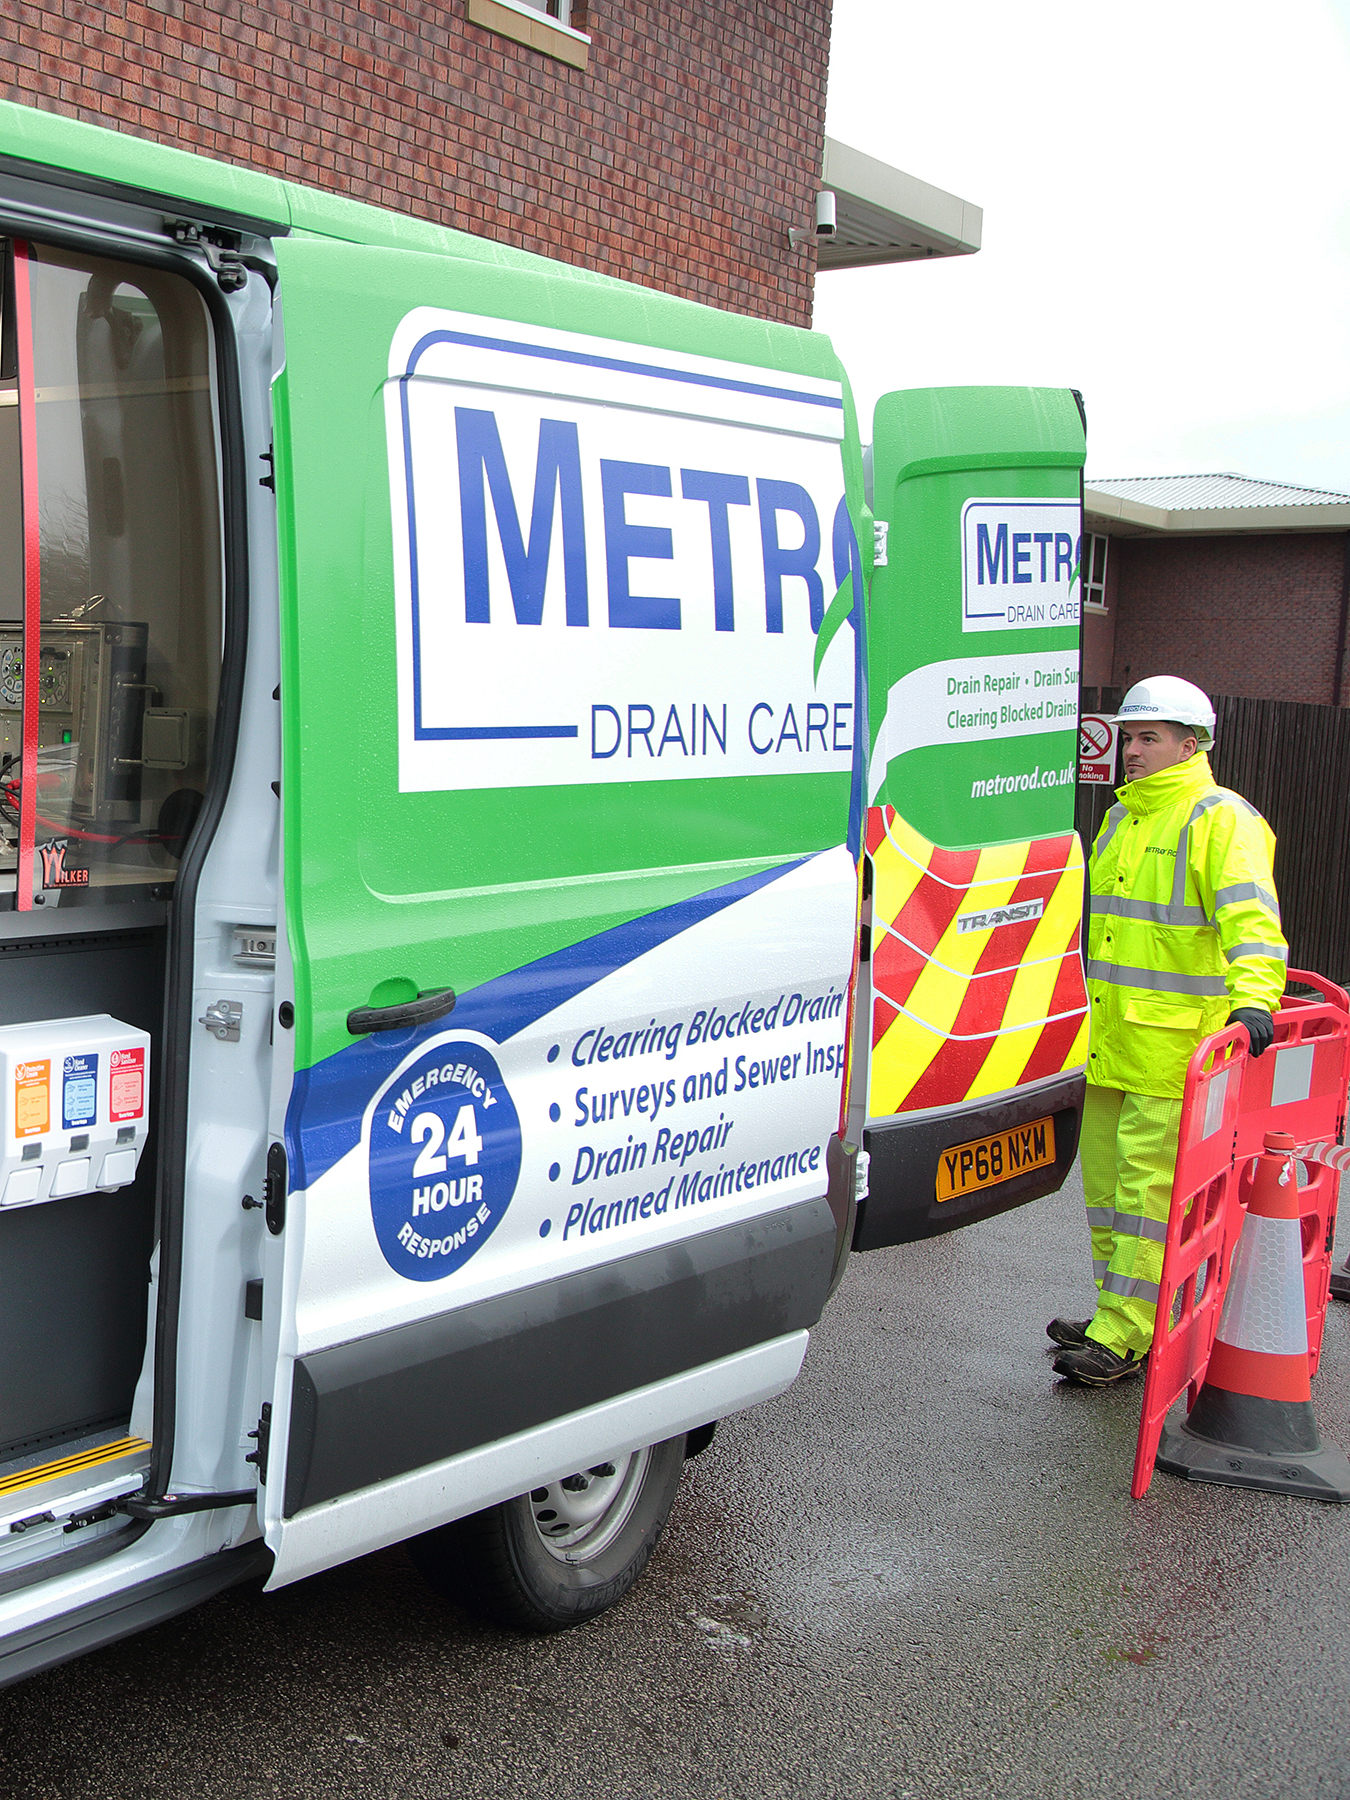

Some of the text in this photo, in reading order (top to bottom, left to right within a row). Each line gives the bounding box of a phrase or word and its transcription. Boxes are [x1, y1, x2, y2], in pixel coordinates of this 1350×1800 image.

[1007, 602, 1080, 623] DRAIN CARE
[947, 678, 981, 696] Drain
[984, 673, 1021, 695] Repair
[1033, 668, 1062, 687] Drain
[591, 701, 853, 760] DRAIN CARE
[947, 700, 1078, 730] Clearing Blocked Drains
[971, 761, 1076, 798] metrorod.co.uk
[1078, 772, 1104, 780] moking
[1081, 764, 1094, 772] No
[42, 846, 89, 884] WILKER
[1166, 848, 1180, 857] RO
[958, 902, 1043, 931] TRANSIT
[571, 985, 844, 1067] Clearing Blocked Drain
[387, 1062, 498, 1134] EMERGENCY
[574, 1041, 844, 1127] Surveys and Sewer Insp
[410, 1104, 483, 1178] 24
[571, 1112, 735, 1186] Drain Repair
[944, 1124, 1046, 1190] YP68 NXM
[412, 1174, 484, 1217] HOUR
[562, 1145, 821, 1241] Planned Maintenance
[396, 1201, 492, 1260] RESPONSE
